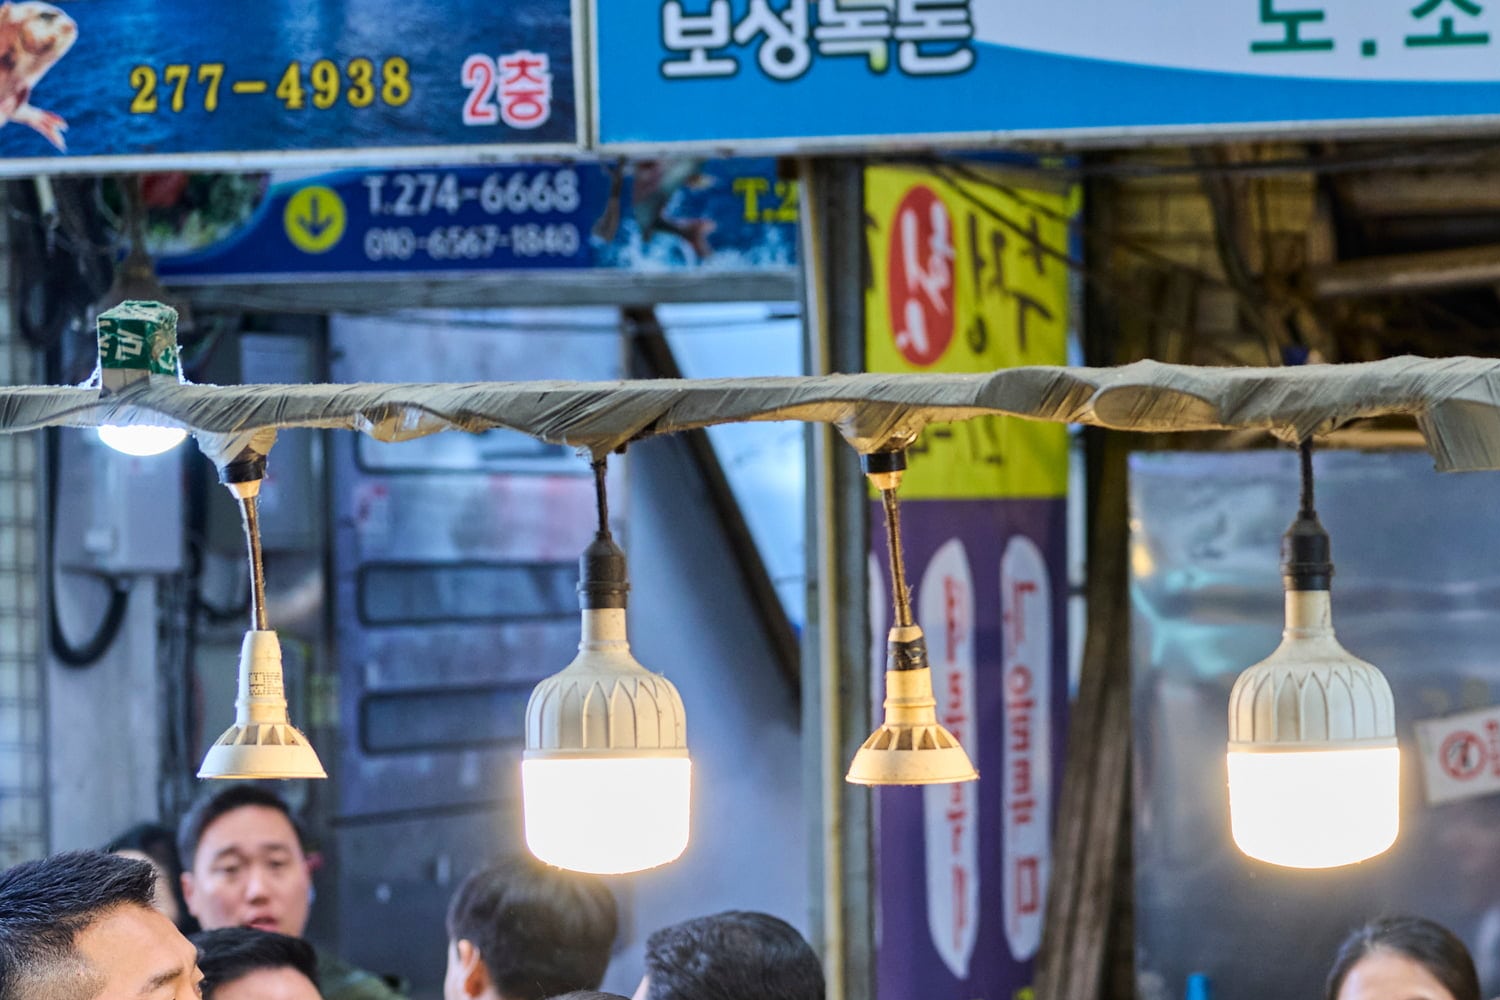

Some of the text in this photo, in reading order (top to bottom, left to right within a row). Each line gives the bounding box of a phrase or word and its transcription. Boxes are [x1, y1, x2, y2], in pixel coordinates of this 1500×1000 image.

[129, 51, 551, 129] 277-4938 2층
[362, 169, 580, 216] T.274-6668
